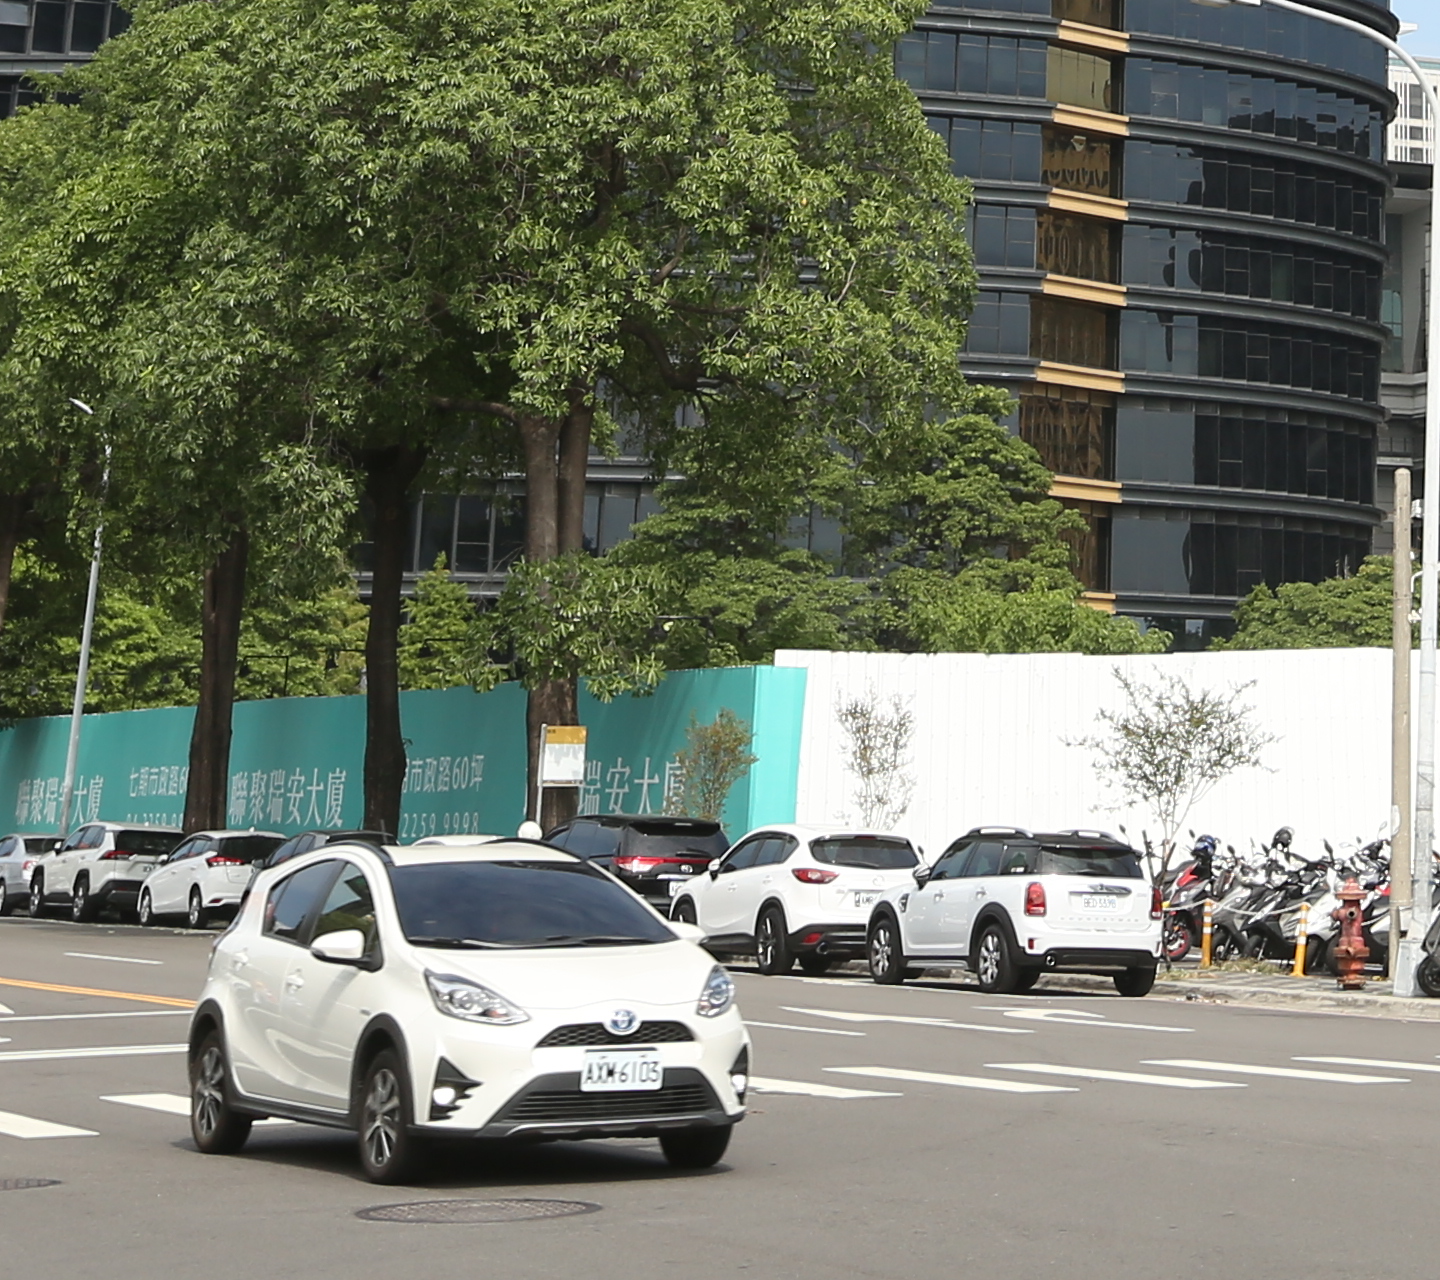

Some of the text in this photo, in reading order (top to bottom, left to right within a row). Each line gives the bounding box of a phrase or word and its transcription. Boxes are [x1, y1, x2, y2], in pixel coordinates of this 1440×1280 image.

[228, 768, 347, 828] 聯聚瑞安大廈
